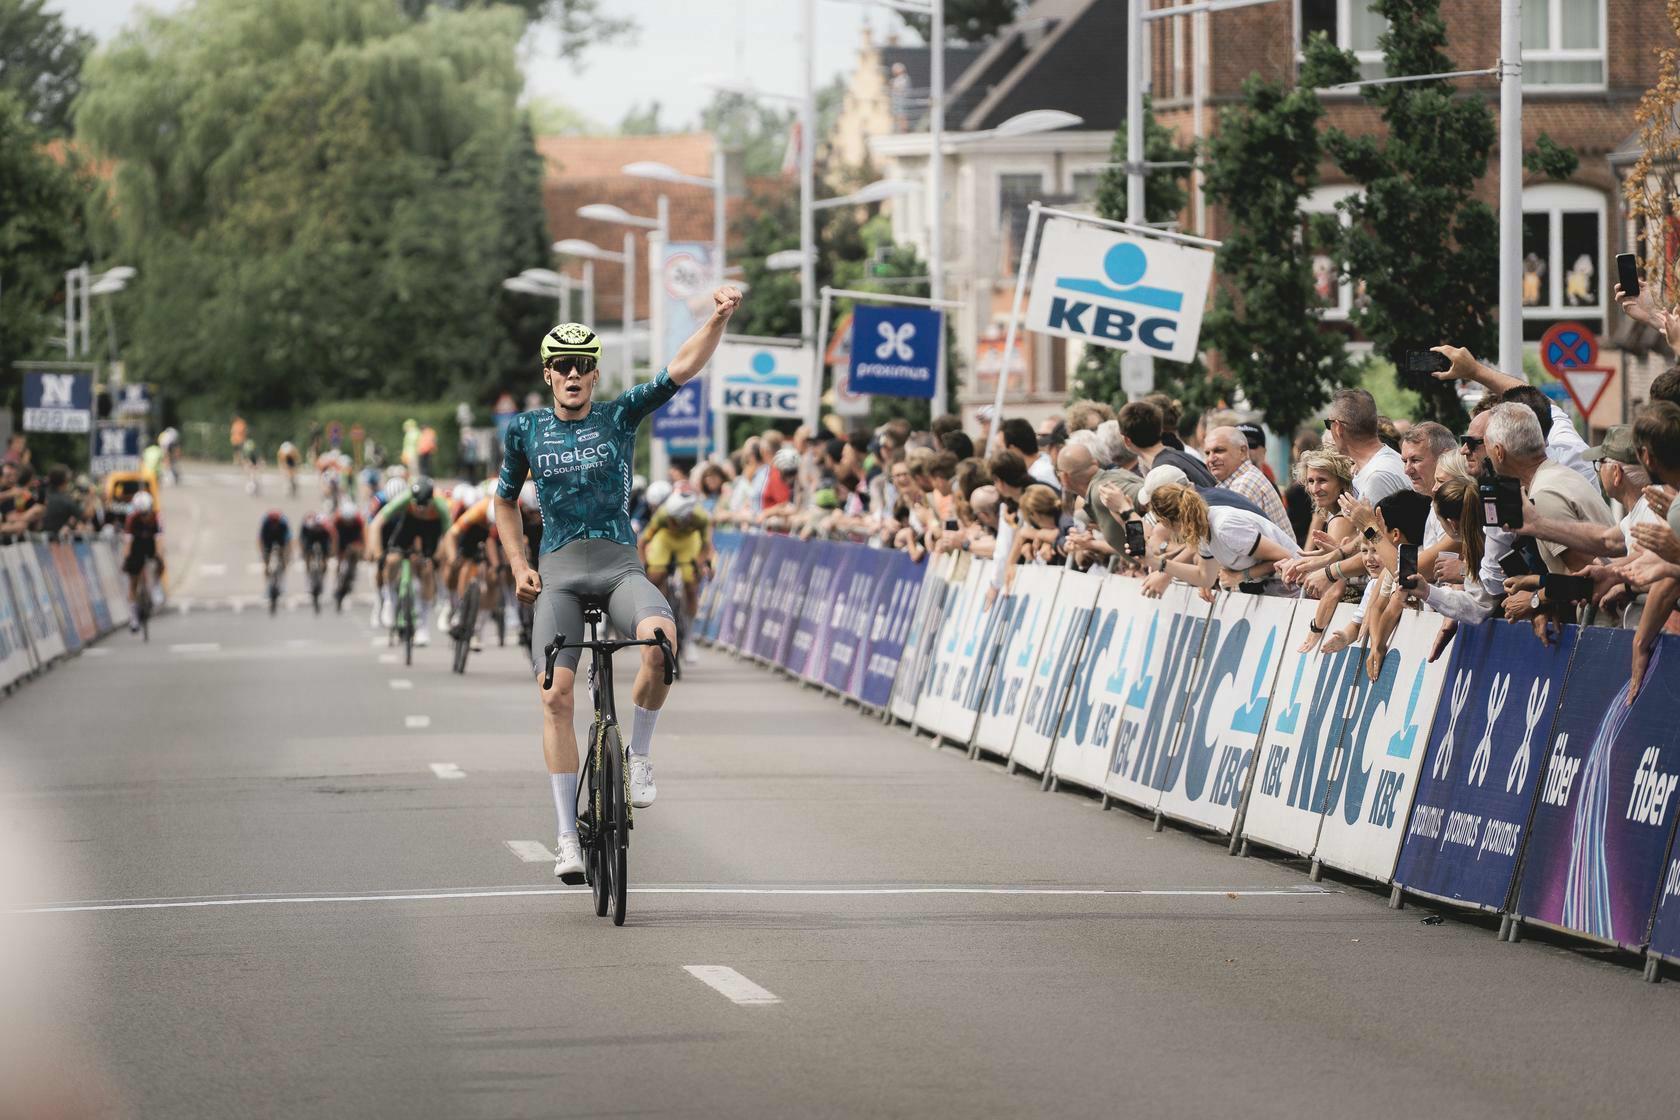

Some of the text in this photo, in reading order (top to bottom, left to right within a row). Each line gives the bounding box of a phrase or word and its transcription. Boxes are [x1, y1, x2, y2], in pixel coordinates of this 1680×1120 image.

[1047, 296, 1178, 351] KBC
[42, 373, 74, 408] N
[723, 388, 798, 412] KBC
[855, 363, 930, 381] proximus
[537, 443, 609, 468] metec
[553, 460, 604, 475] SOLARWATT
[1036, 607, 1119, 746] KBC
[1130, 613, 1251, 802] KBC
[1285, 646, 1401, 826] KBC
[1208, 744, 1254, 810] KBC
[1260, 744, 1291, 799] KBC
[1541, 732, 1581, 807] fiber
[1625, 746, 1679, 827] fiber
[1368, 769, 1405, 830] KBC
[1406, 804, 1521, 861] proximus proximus proximus
